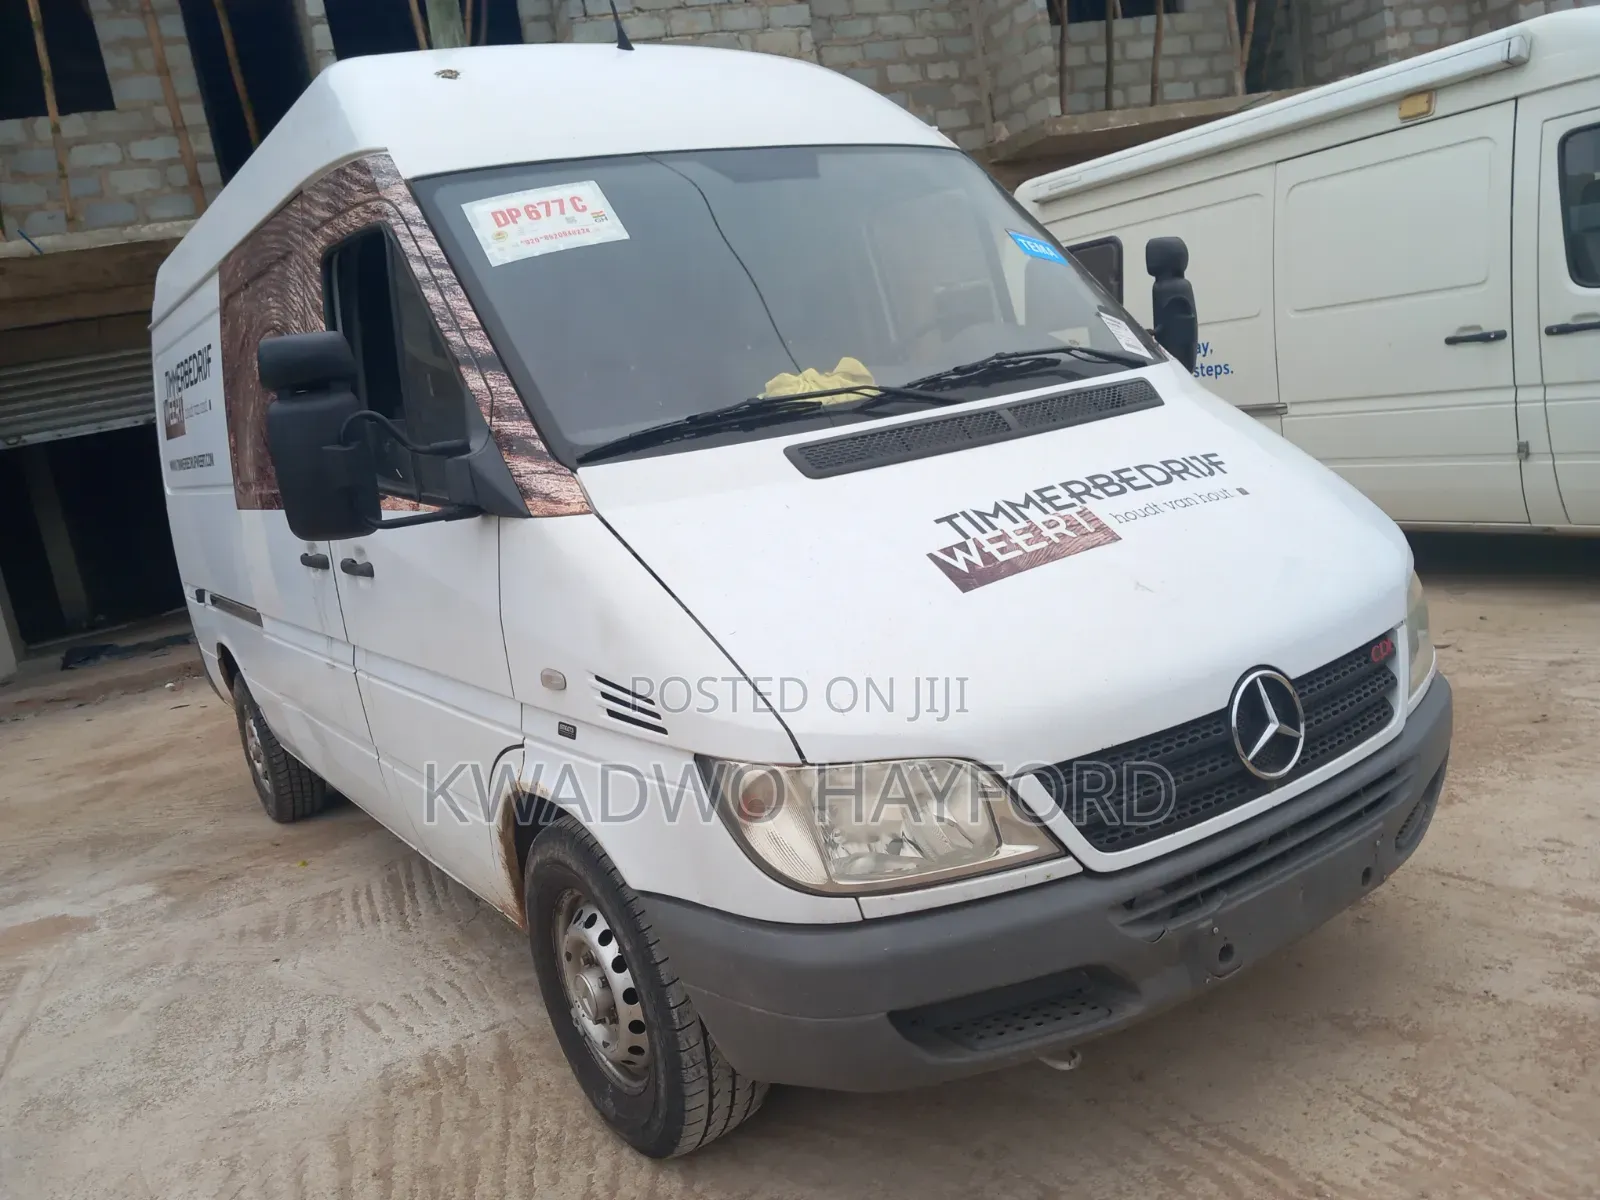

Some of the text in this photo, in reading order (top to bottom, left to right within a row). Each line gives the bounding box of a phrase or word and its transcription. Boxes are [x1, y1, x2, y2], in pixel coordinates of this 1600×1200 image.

[490, 195, 589, 229] DP 677 C
[1017, 238, 1060, 258] TEMA
[1193, 362, 1235, 381] steps.
[934, 452, 1229, 539] TIMMERBEDRIJF
[1109, 488, 1233, 525] houdt van hout
